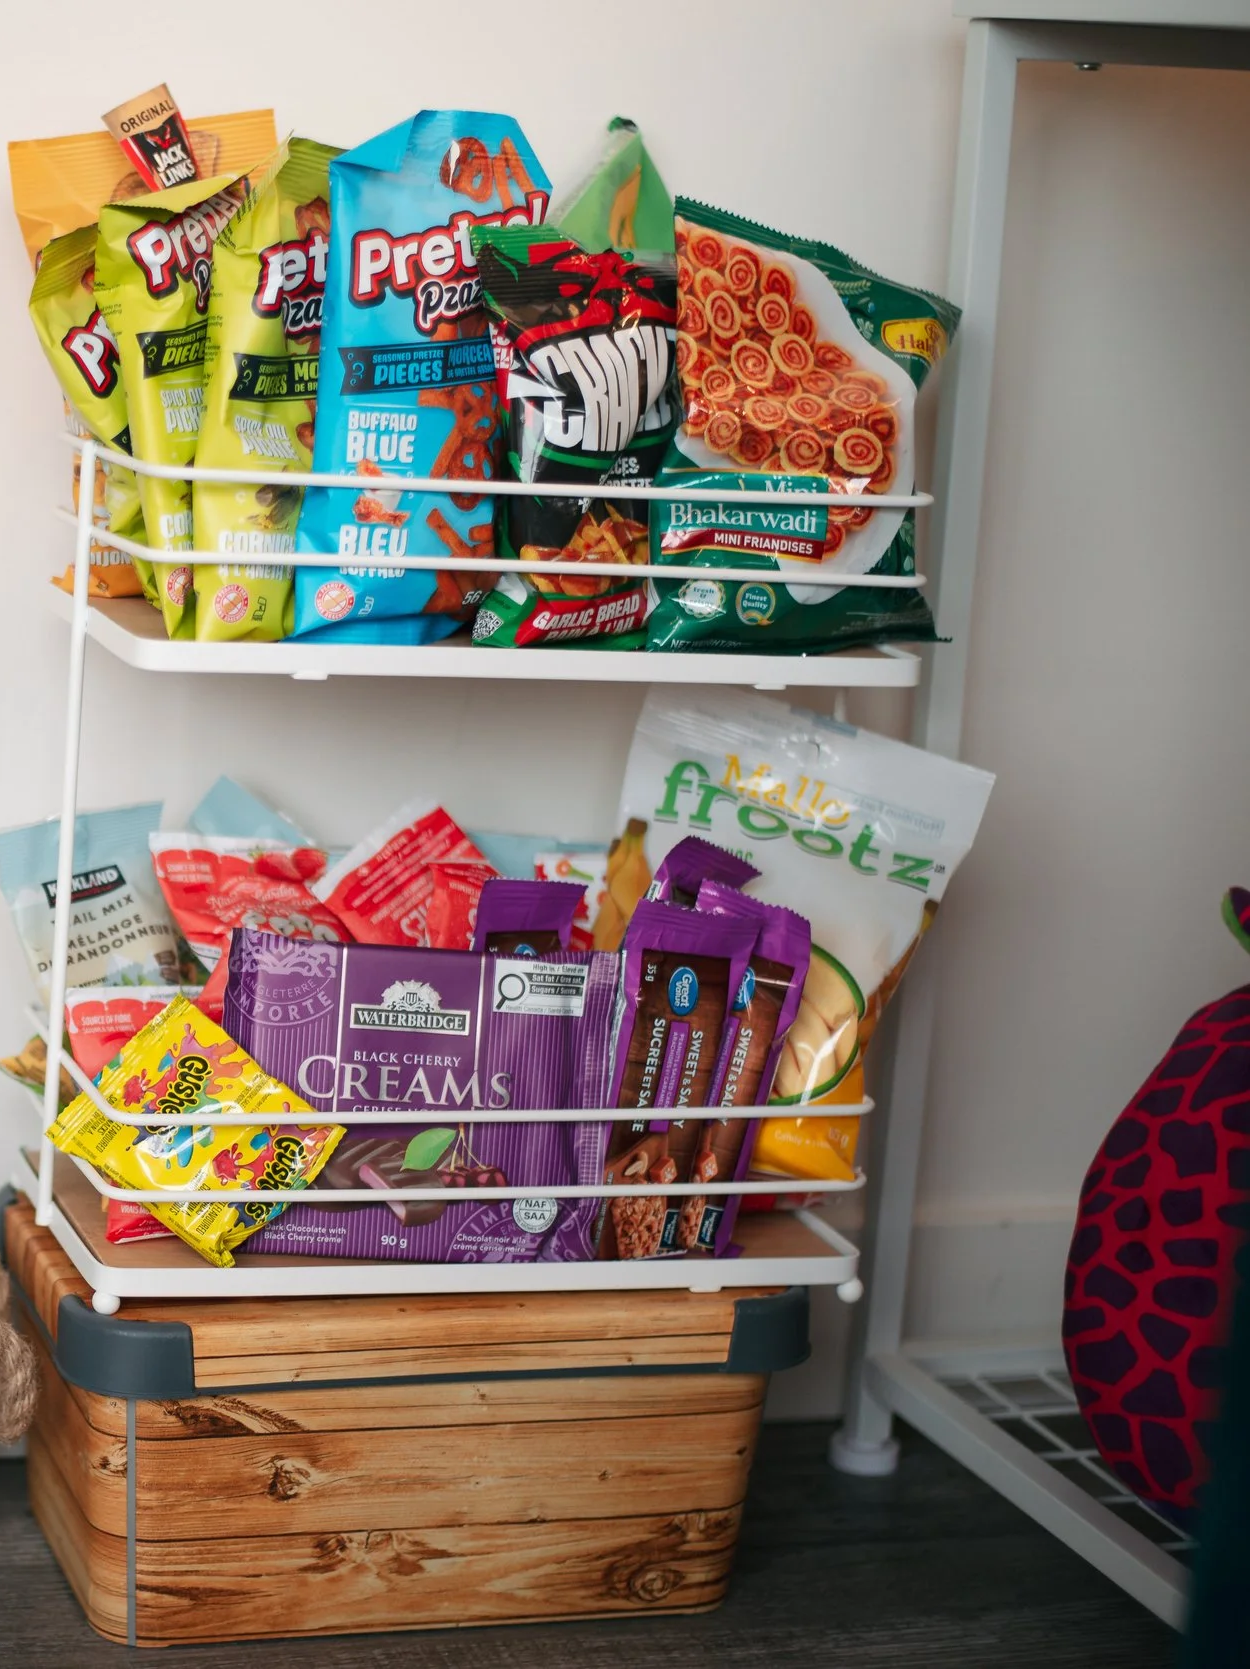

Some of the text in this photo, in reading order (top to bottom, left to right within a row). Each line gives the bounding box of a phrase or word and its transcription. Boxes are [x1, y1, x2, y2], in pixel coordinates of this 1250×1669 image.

[120, 100, 174, 133] ORIGINAL
[153, 144, 188, 172] JACK
[358, 197, 543, 295] Pretl
[417, 279, 484, 329] Pzaz
[372, 349, 444, 364] SEASONED PRETZEL
[449, 343, 492, 366] MORCEA
[374, 360, 443, 386] PIECES
[295, 383, 305, 392] DE
[165, 406, 200, 434] PICK
[348, 411, 418, 432] BUFFALO
[346, 431, 414, 463] BLUE
[670, 503, 817, 534] Bhakarwadi
[338, 524, 408, 557] BLEU
[714, 532, 813, 555] MINI FRIANDISES
[743, 600, 768, 610] Quality
[745, 593, 767, 601] Finest
[532, 594, 640, 630] GARLIC BREAD
[720, 754, 850, 826] Mallo
[654, 760, 935, 892] frootz
[46, 869, 119, 897] KKLAND
[102, 894, 134, 916] MIX
[68, 914, 143, 949] MÉLANGE
[533, 964, 547, 972] High
[647, 963, 656, 974] 35
[233, 985, 332, 1021] IMPORTÉ
[531, 986, 555, 995] Sugars
[681, 973, 693, 1008] Great
[356, 1011, 463, 1030] WATERBRIDGE
[353, 1051, 462, 1067] BLACK CHERRY
[686, 1031, 703, 1077] SWEET
[732, 1028, 753, 1075] SWEET
[297, 1055, 513, 1109] CREAMS
[632, 1018, 666, 1132] SUCRÉE ET SAE
[673, 1088, 692, 1129] SAY
[719, 1083, 737, 1127] SALY
[96, 1122, 122, 1153] FLAVOURED
[98, 1119, 114, 1136] NACKS
[524, 1212, 546, 1221] SAA
[525, 1199, 547, 1208] NAF
[196, 1204, 222, 1235] FLAVOURED
[264, 1223, 347, 1234] Dark Chocolate with
[264, 1232, 314, 1243] Black Cherry
[380, 1235, 407, 1249] 90 g
[453, 1243, 477, 1251] crème
[456, 1234, 492, 1243] Chocolat
